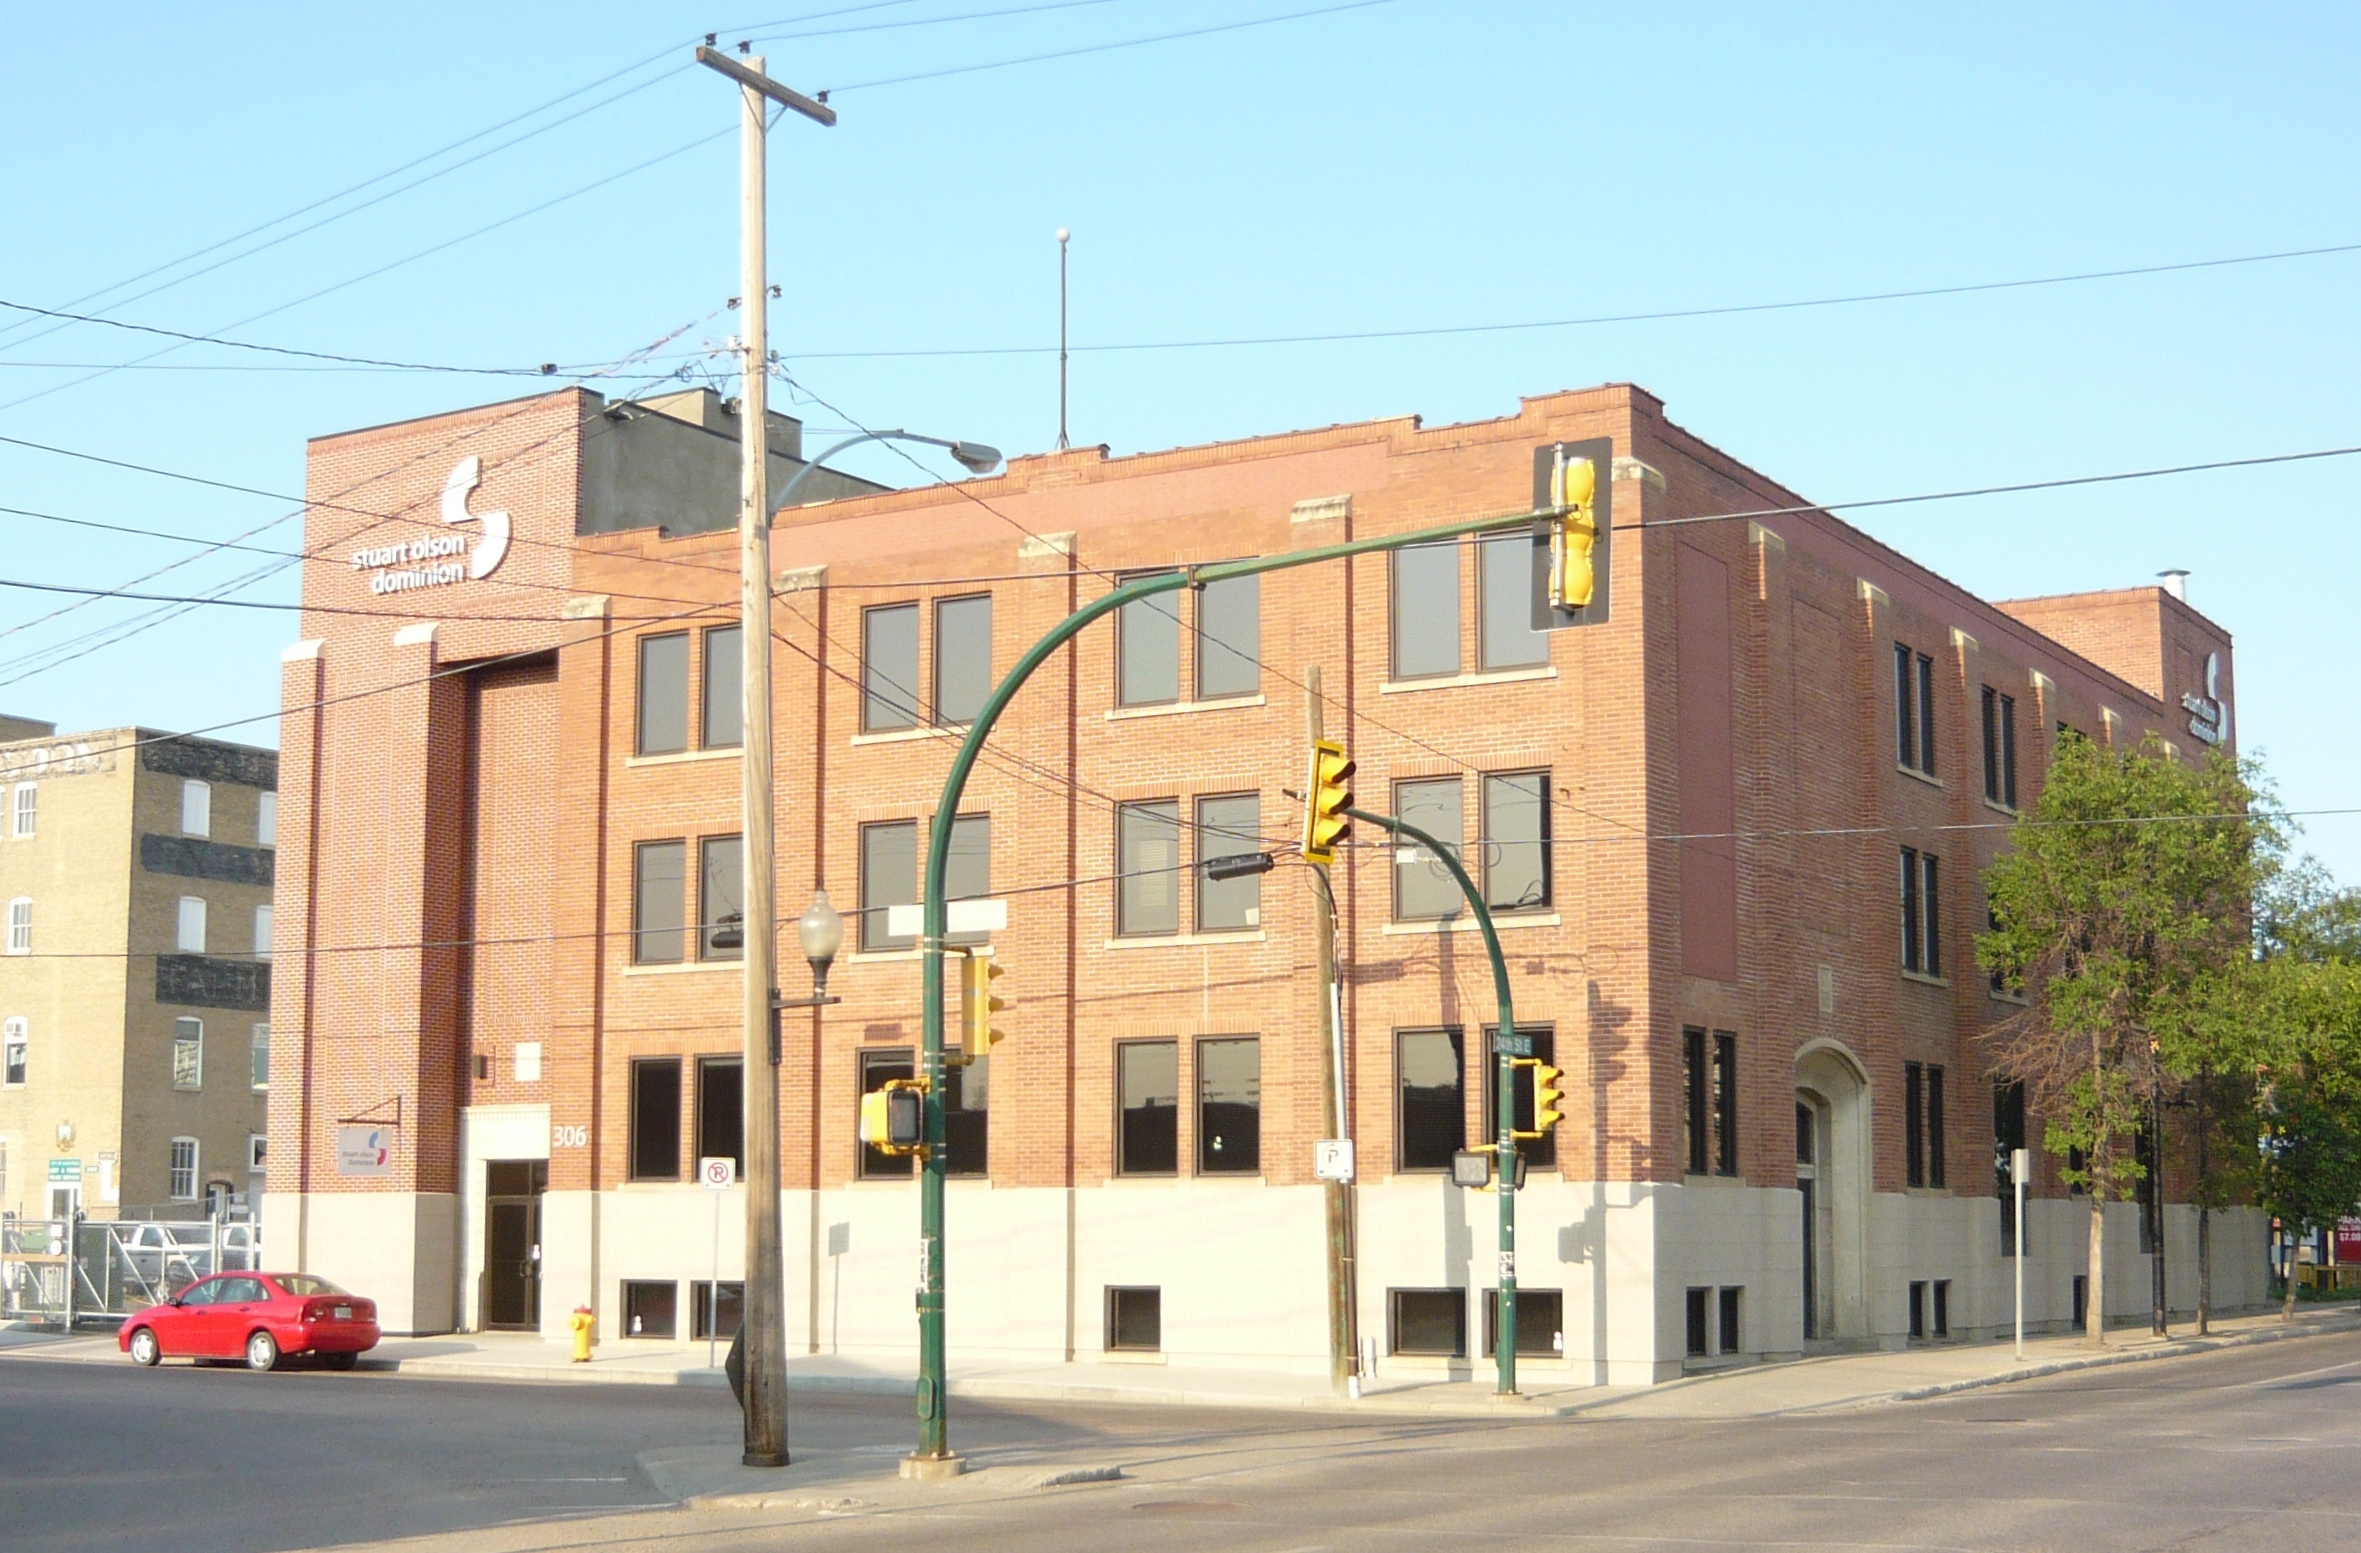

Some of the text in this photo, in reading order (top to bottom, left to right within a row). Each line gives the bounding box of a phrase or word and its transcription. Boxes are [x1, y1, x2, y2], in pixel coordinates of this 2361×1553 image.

[353, 533, 465, 569] stuart olson
[372, 561, 464, 595] dominion
[552, 1124, 587, 1148] 306
